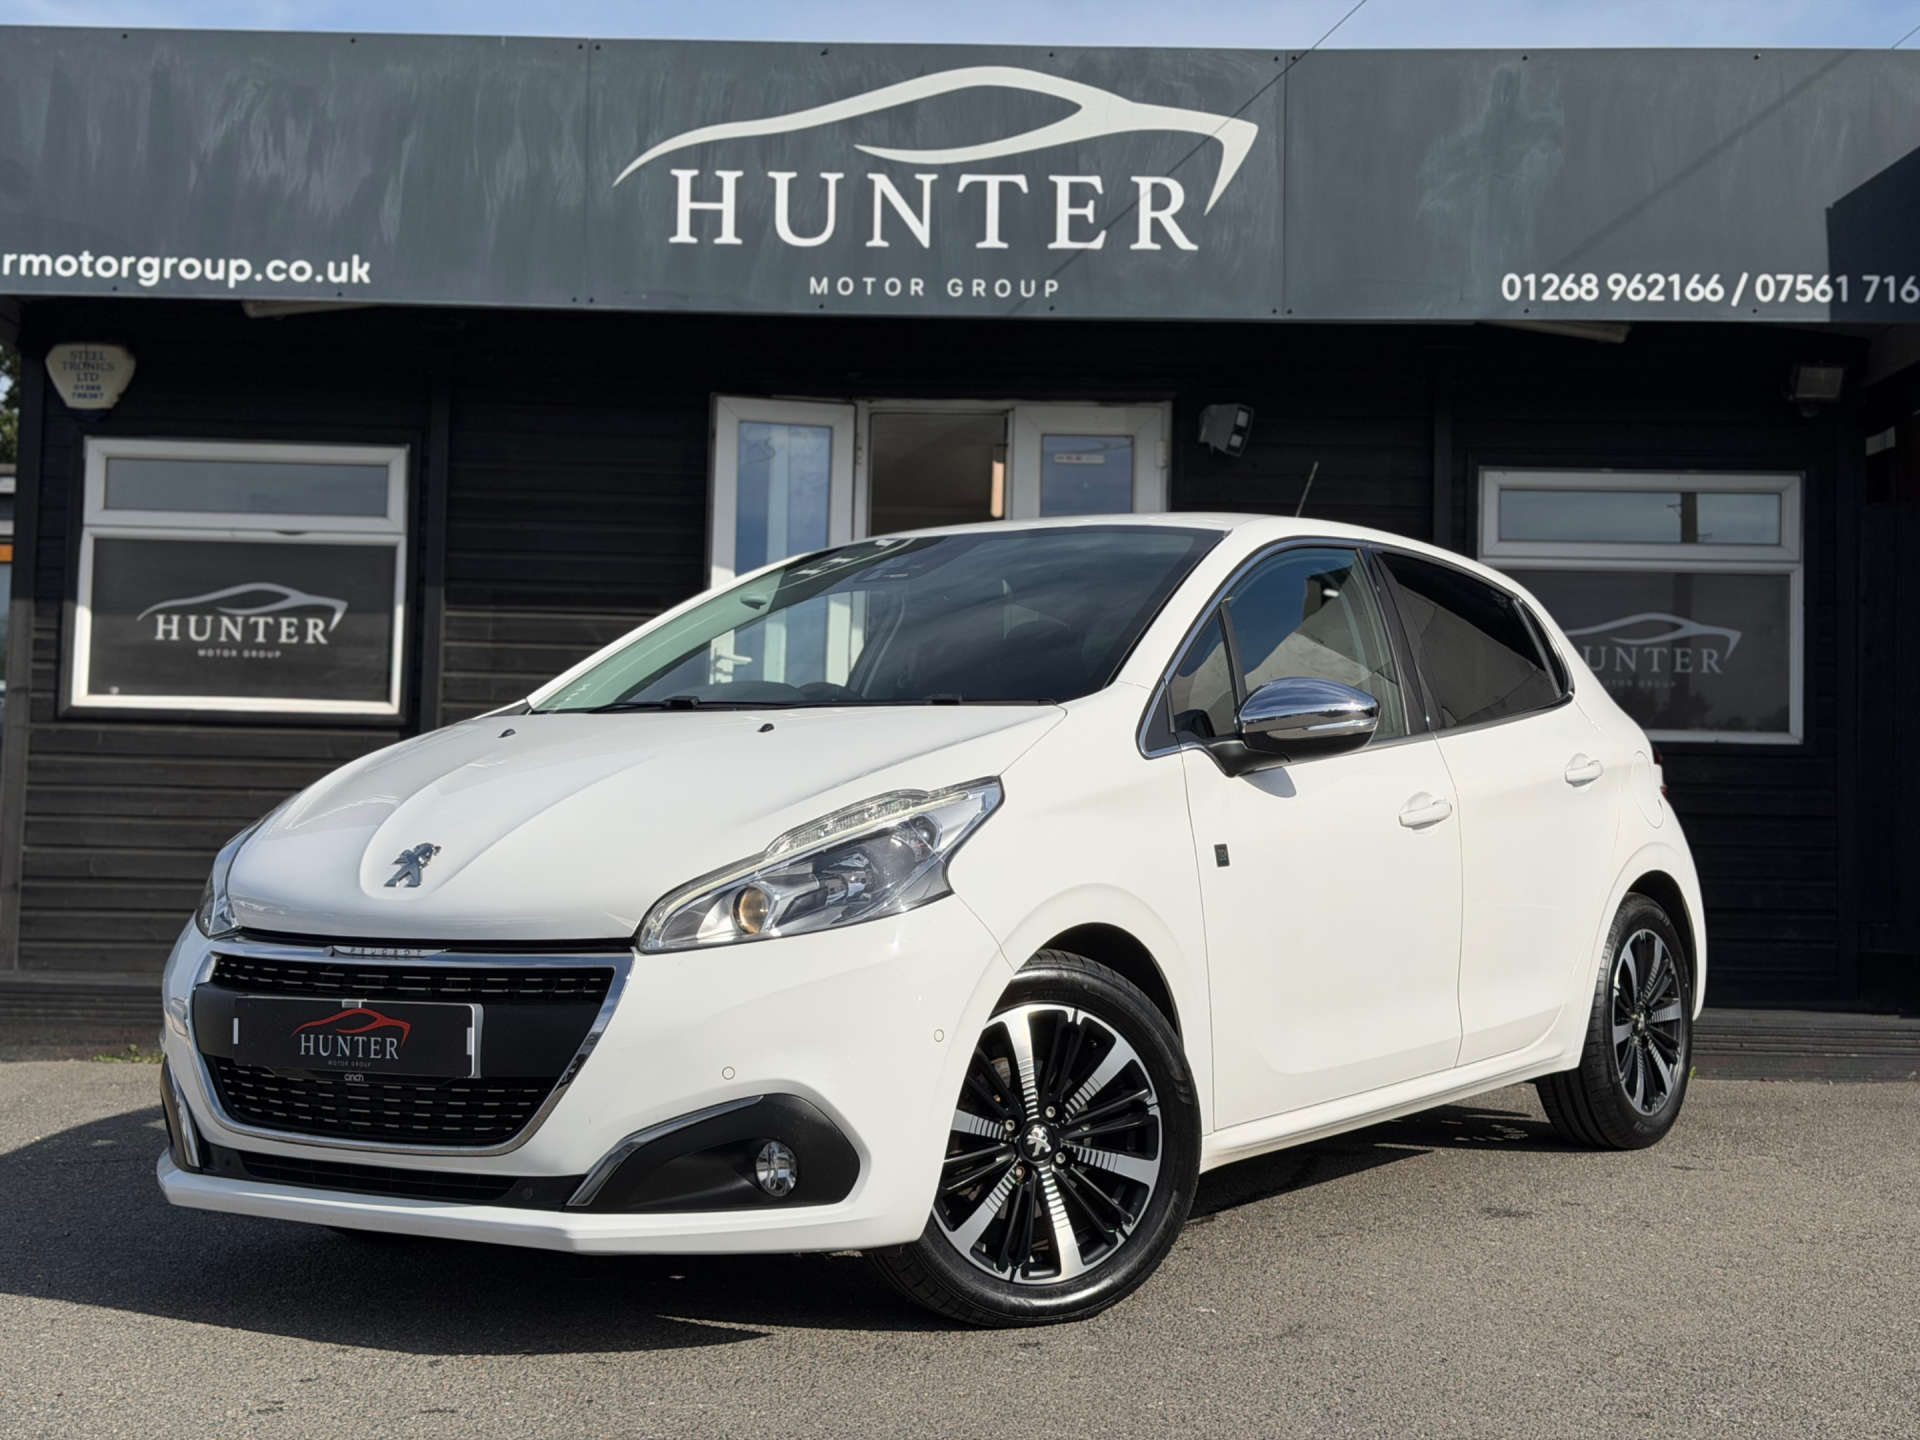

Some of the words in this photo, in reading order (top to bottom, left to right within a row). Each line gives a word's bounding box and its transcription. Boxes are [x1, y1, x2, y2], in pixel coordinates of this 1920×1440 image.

[668, 168, 1199, 251] HUNTER
[2, 250, 371, 288] rmotorgroup.co.uk
[809, 275, 925, 297] MOTOR
[946, 276, 1060, 298] GROUP
[1501, 273, 1599, 302] 01268
[1607, 273, 1725, 302] 962166
[1731, 272, 1749, 307] /
[1755, 274, 1850, 303] 07561
[1862, 274, 1920, 304] 716
[76, 372, 100, 382] LTD
[154, 613, 329, 645] HUNTER
[197, 648, 238, 658] MOTOR
[242, 649, 282, 659] GROUP
[1582, 645, 1723, 674] UNTER
[300, 1033, 400, 1060] HUNTER
